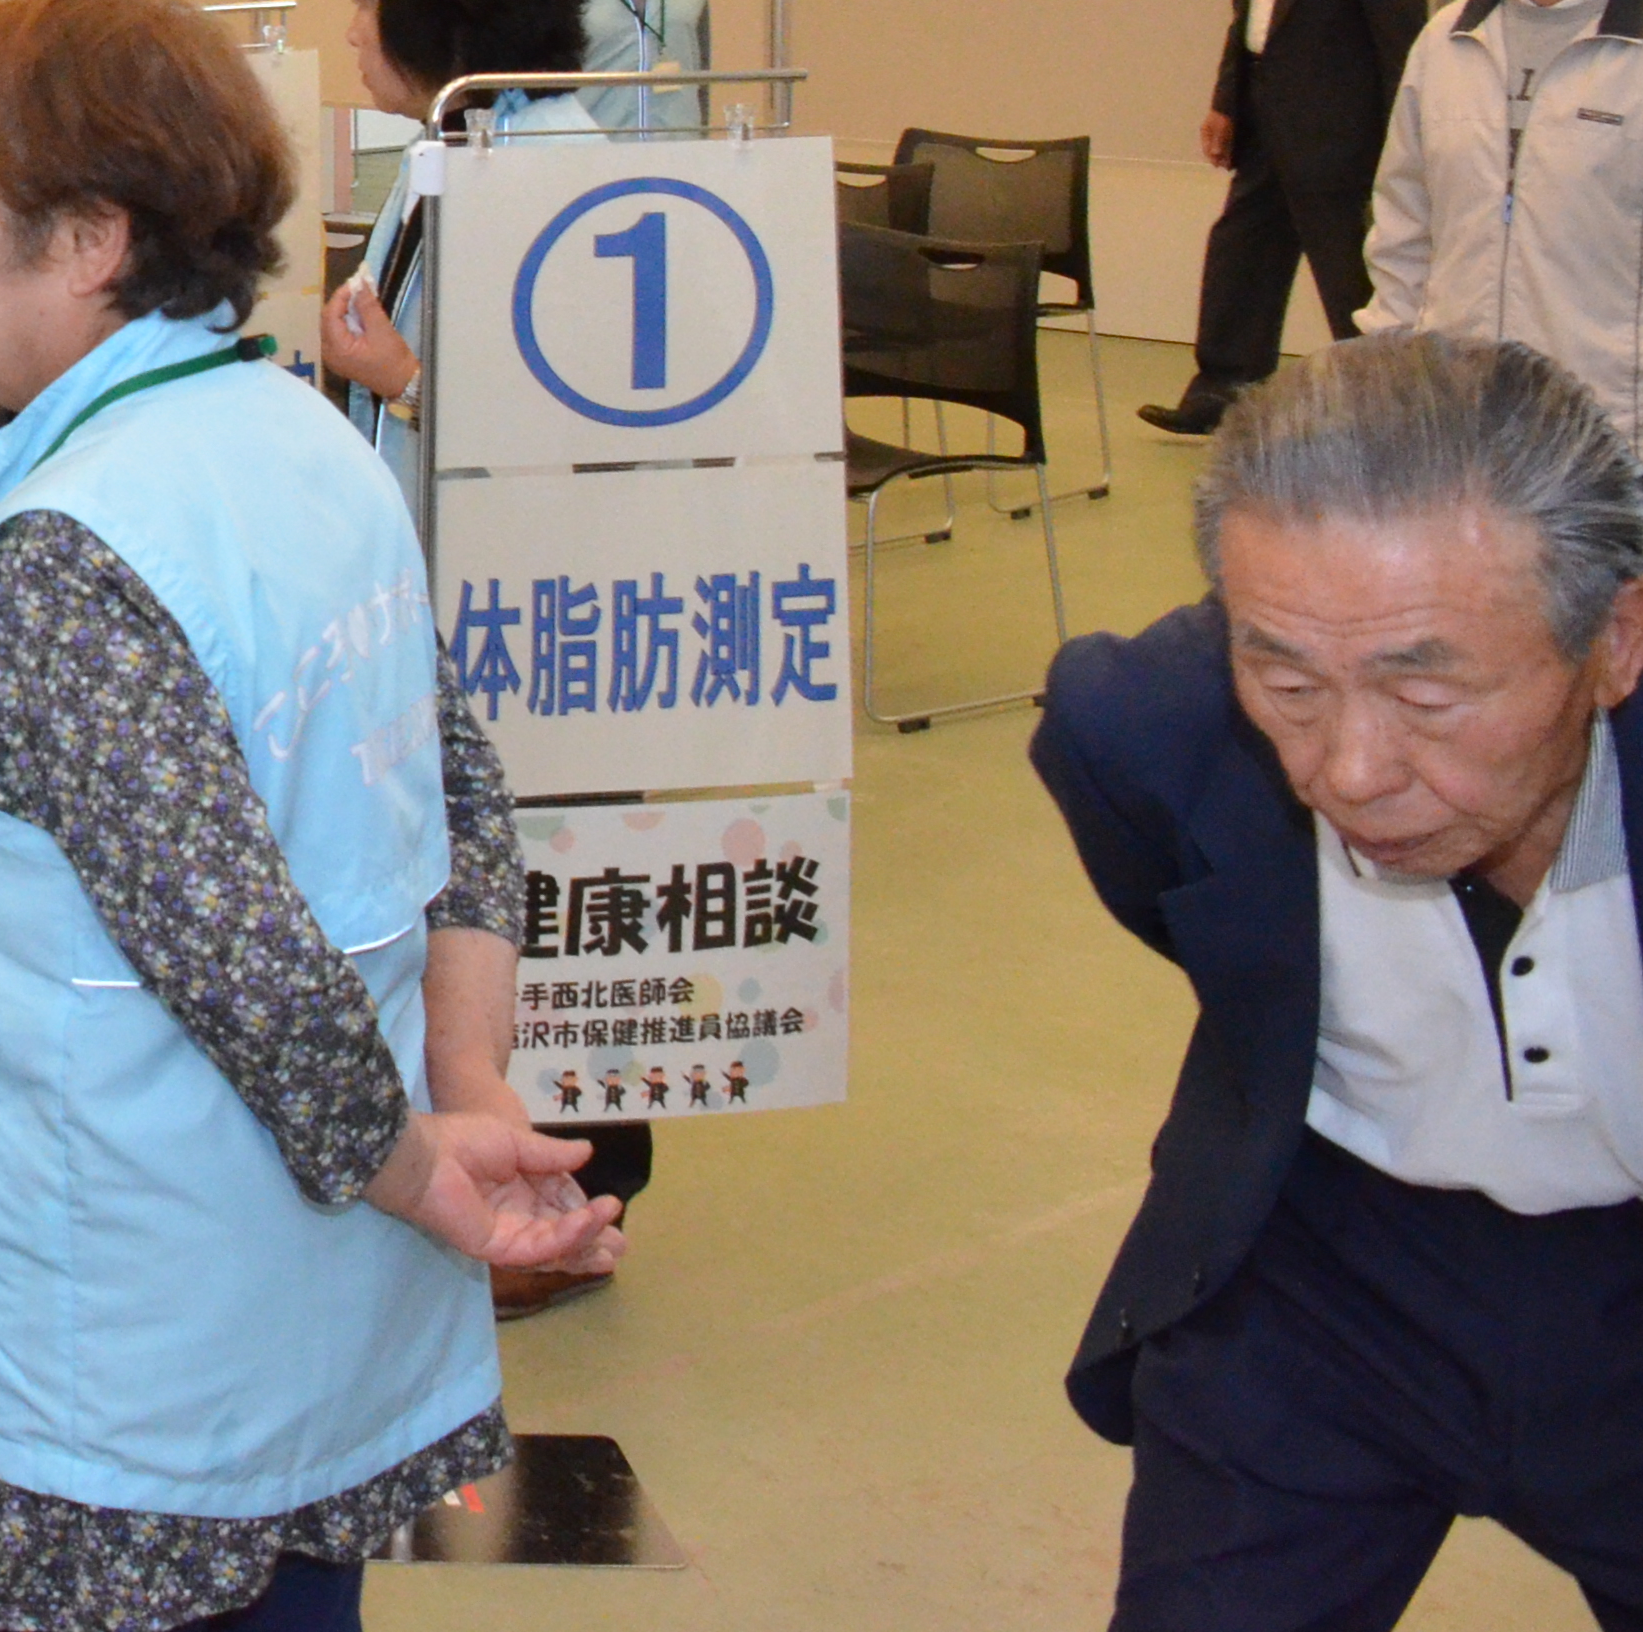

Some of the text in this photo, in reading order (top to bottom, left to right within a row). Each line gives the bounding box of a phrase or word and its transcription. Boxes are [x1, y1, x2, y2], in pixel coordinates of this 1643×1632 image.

[449, 562, 839, 721] 体脂肪測定
[515, 976, 695, 1011] 手西北医師会
[512, 1007, 806, 1051] 沢市保健推進員協議会
